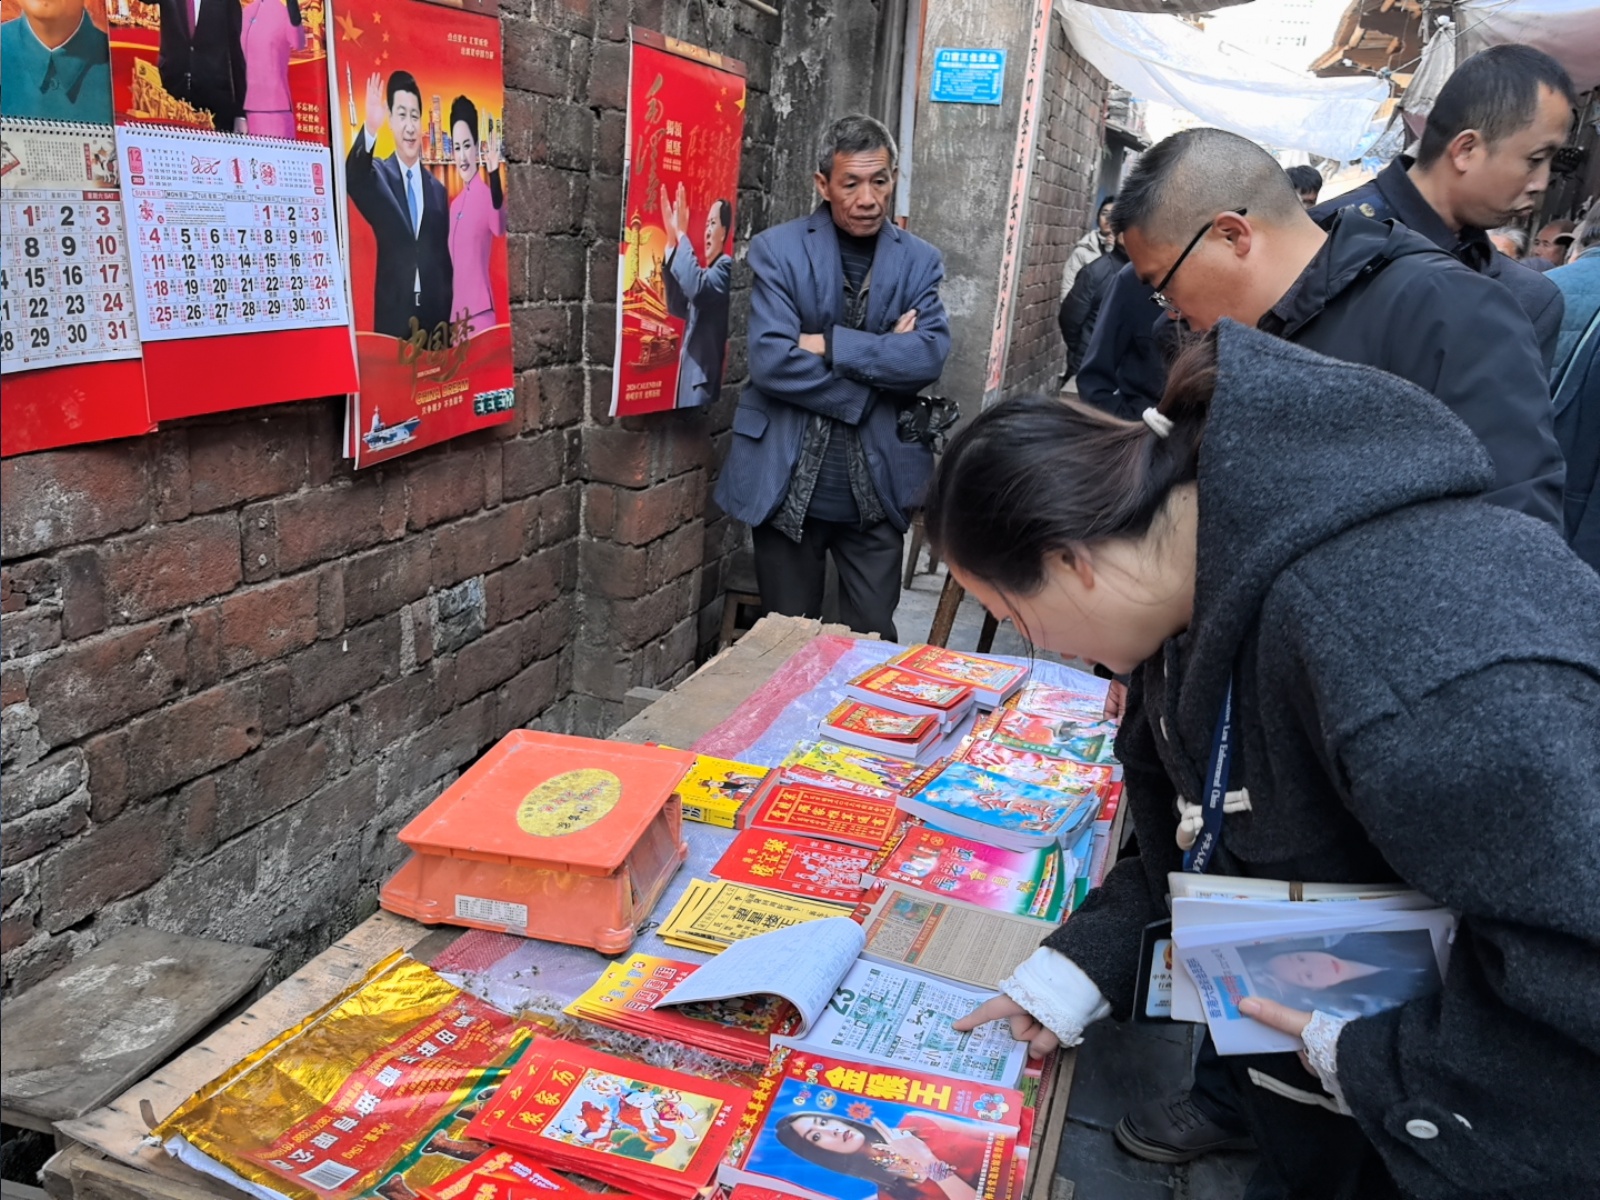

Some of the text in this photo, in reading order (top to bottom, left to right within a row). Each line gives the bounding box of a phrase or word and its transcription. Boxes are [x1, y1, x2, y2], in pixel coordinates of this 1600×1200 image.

[129, 150, 141, 161] 12
[231, 158, 241, 184] 1
[315, 166, 320, 175] 2
[24, 206, 110, 226] 1 2 3
[263, 205, 319, 221] 1 2 3
[25, 235, 117, 257] 8 9 10
[150, 228, 322, 244] 4 5 6 7 8 9 10
[152, 253, 323, 270] 11 12 13 14 15 16 17
[25, 268, 45, 288] 15
[63, 266, 83, 285] 16
[100, 265, 119, 283] 17
[154, 276, 328, 296] 18 19 20 21 22 23 24
[30, 298, 48, 318] 22
[66, 295, 85, 314] 23
[103, 293, 123, 311] 24
[156, 297, 331, 322] 25 26 27 28 29 30 31
[31, 327, 50, 348] 29
[68, 324, 87, 343] 30
[108, 321, 127, 339] 31
[415, 378, 470, 405] CHINA DREAM
[519, 1067, 575, 1126] 农家历
[823, 1065, 952, 1111] 金猴王
[343, 1139, 363, 1160] 15kg
